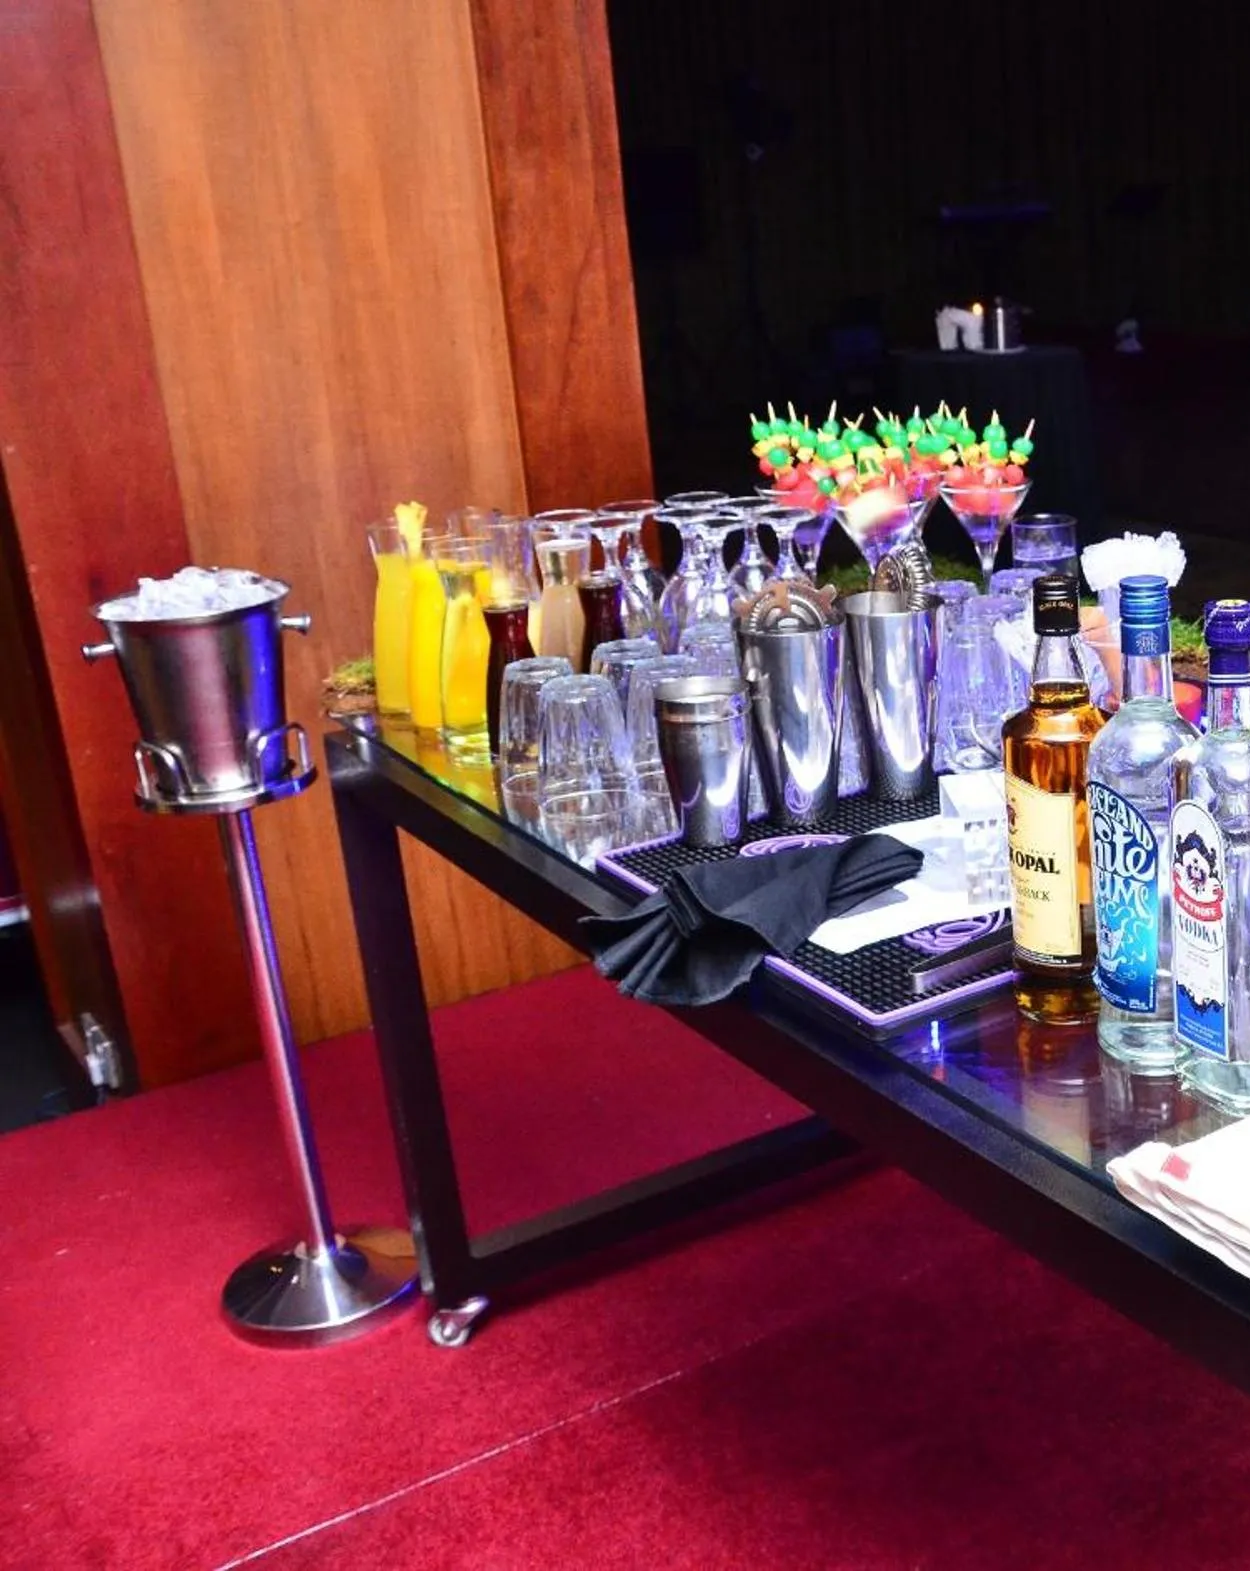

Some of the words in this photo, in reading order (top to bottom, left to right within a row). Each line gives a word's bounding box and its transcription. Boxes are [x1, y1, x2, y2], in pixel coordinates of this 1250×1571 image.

[1090, 784, 1154, 852] KLAND
[1015, 850, 1061, 875] OPAL
[1178, 914, 1220, 948] VODKA
